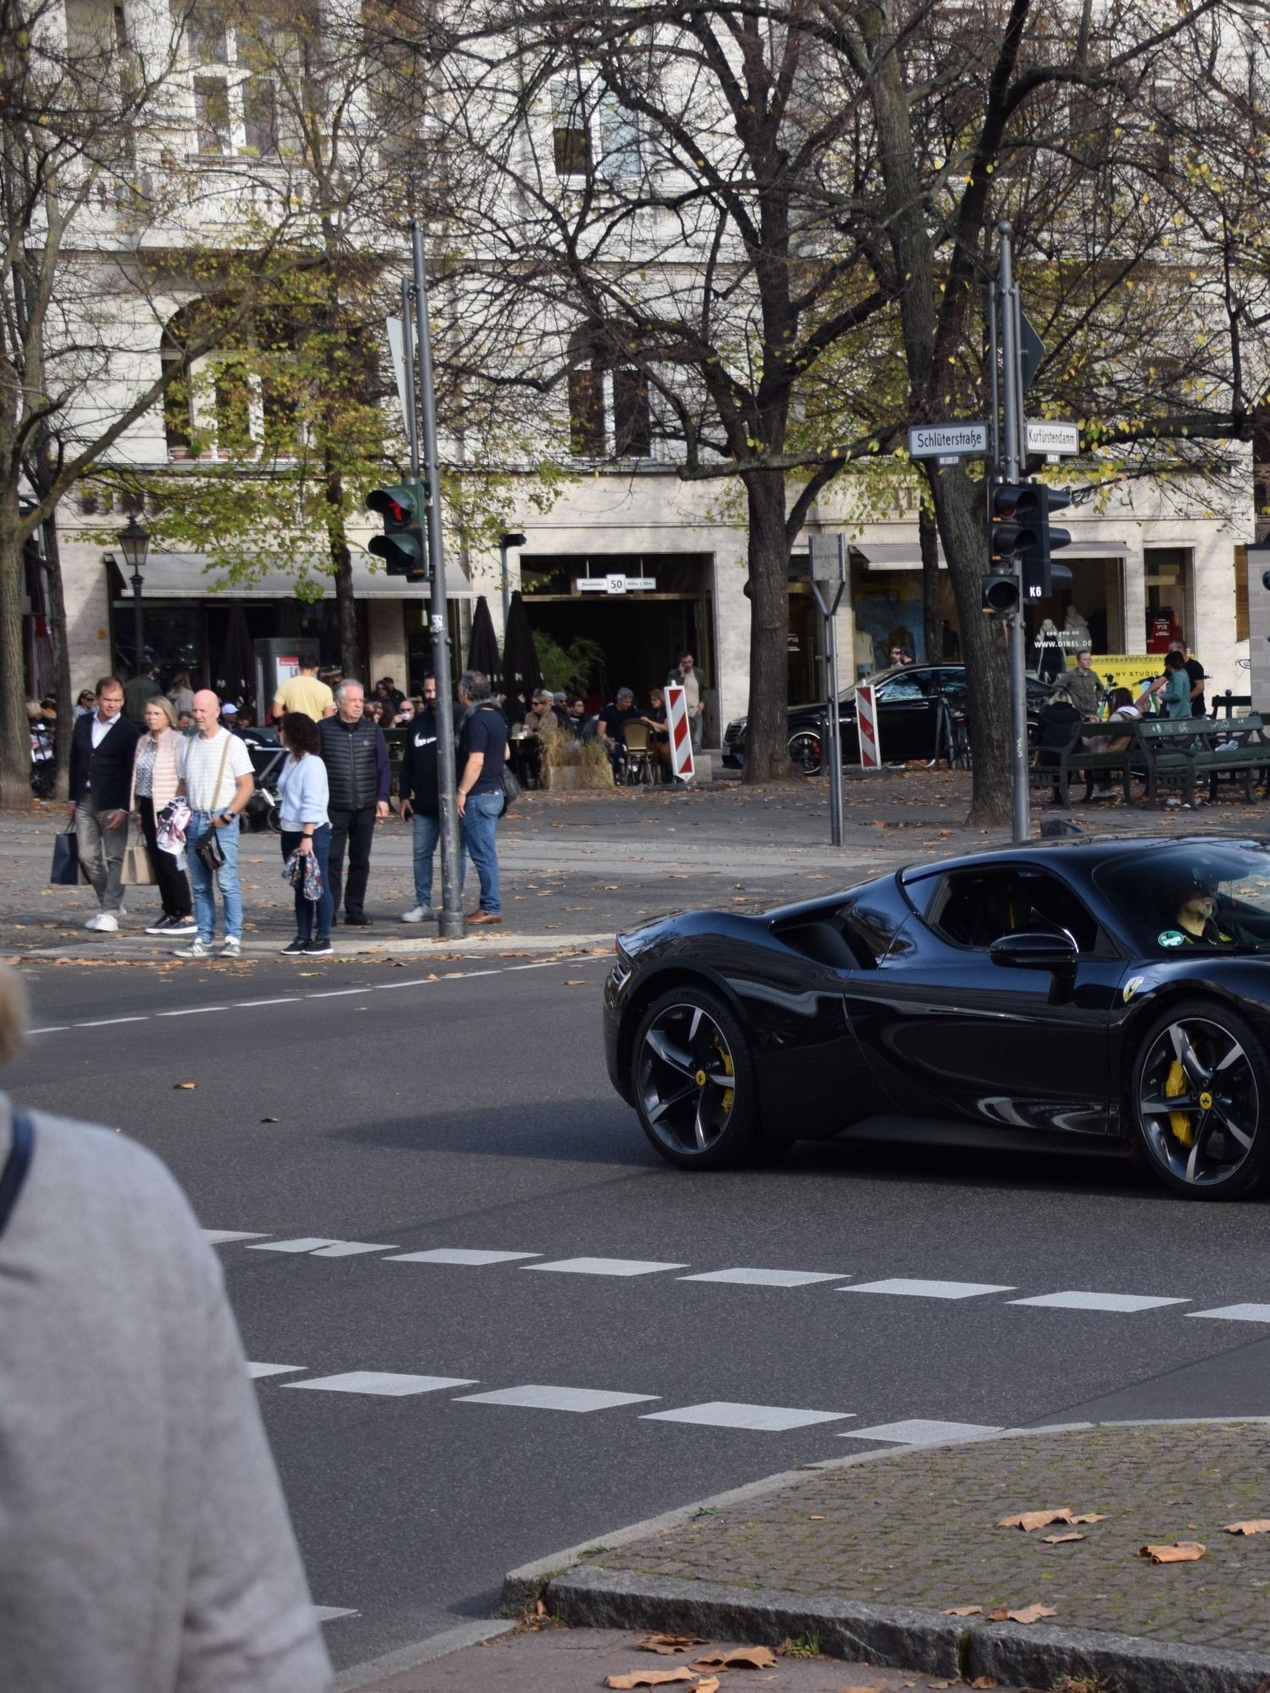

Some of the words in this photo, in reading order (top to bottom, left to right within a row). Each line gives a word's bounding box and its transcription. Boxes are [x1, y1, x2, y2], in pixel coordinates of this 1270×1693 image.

[917, 430, 982, 448] Schlüterstraße
[1028, 430, 1075, 445] Kurfürstendamm
[610, 579, 623, 589] 50
[1029, 587, 1042, 597] K6
[1034, 639, 1092, 649] WWW.DIBEL.DE
